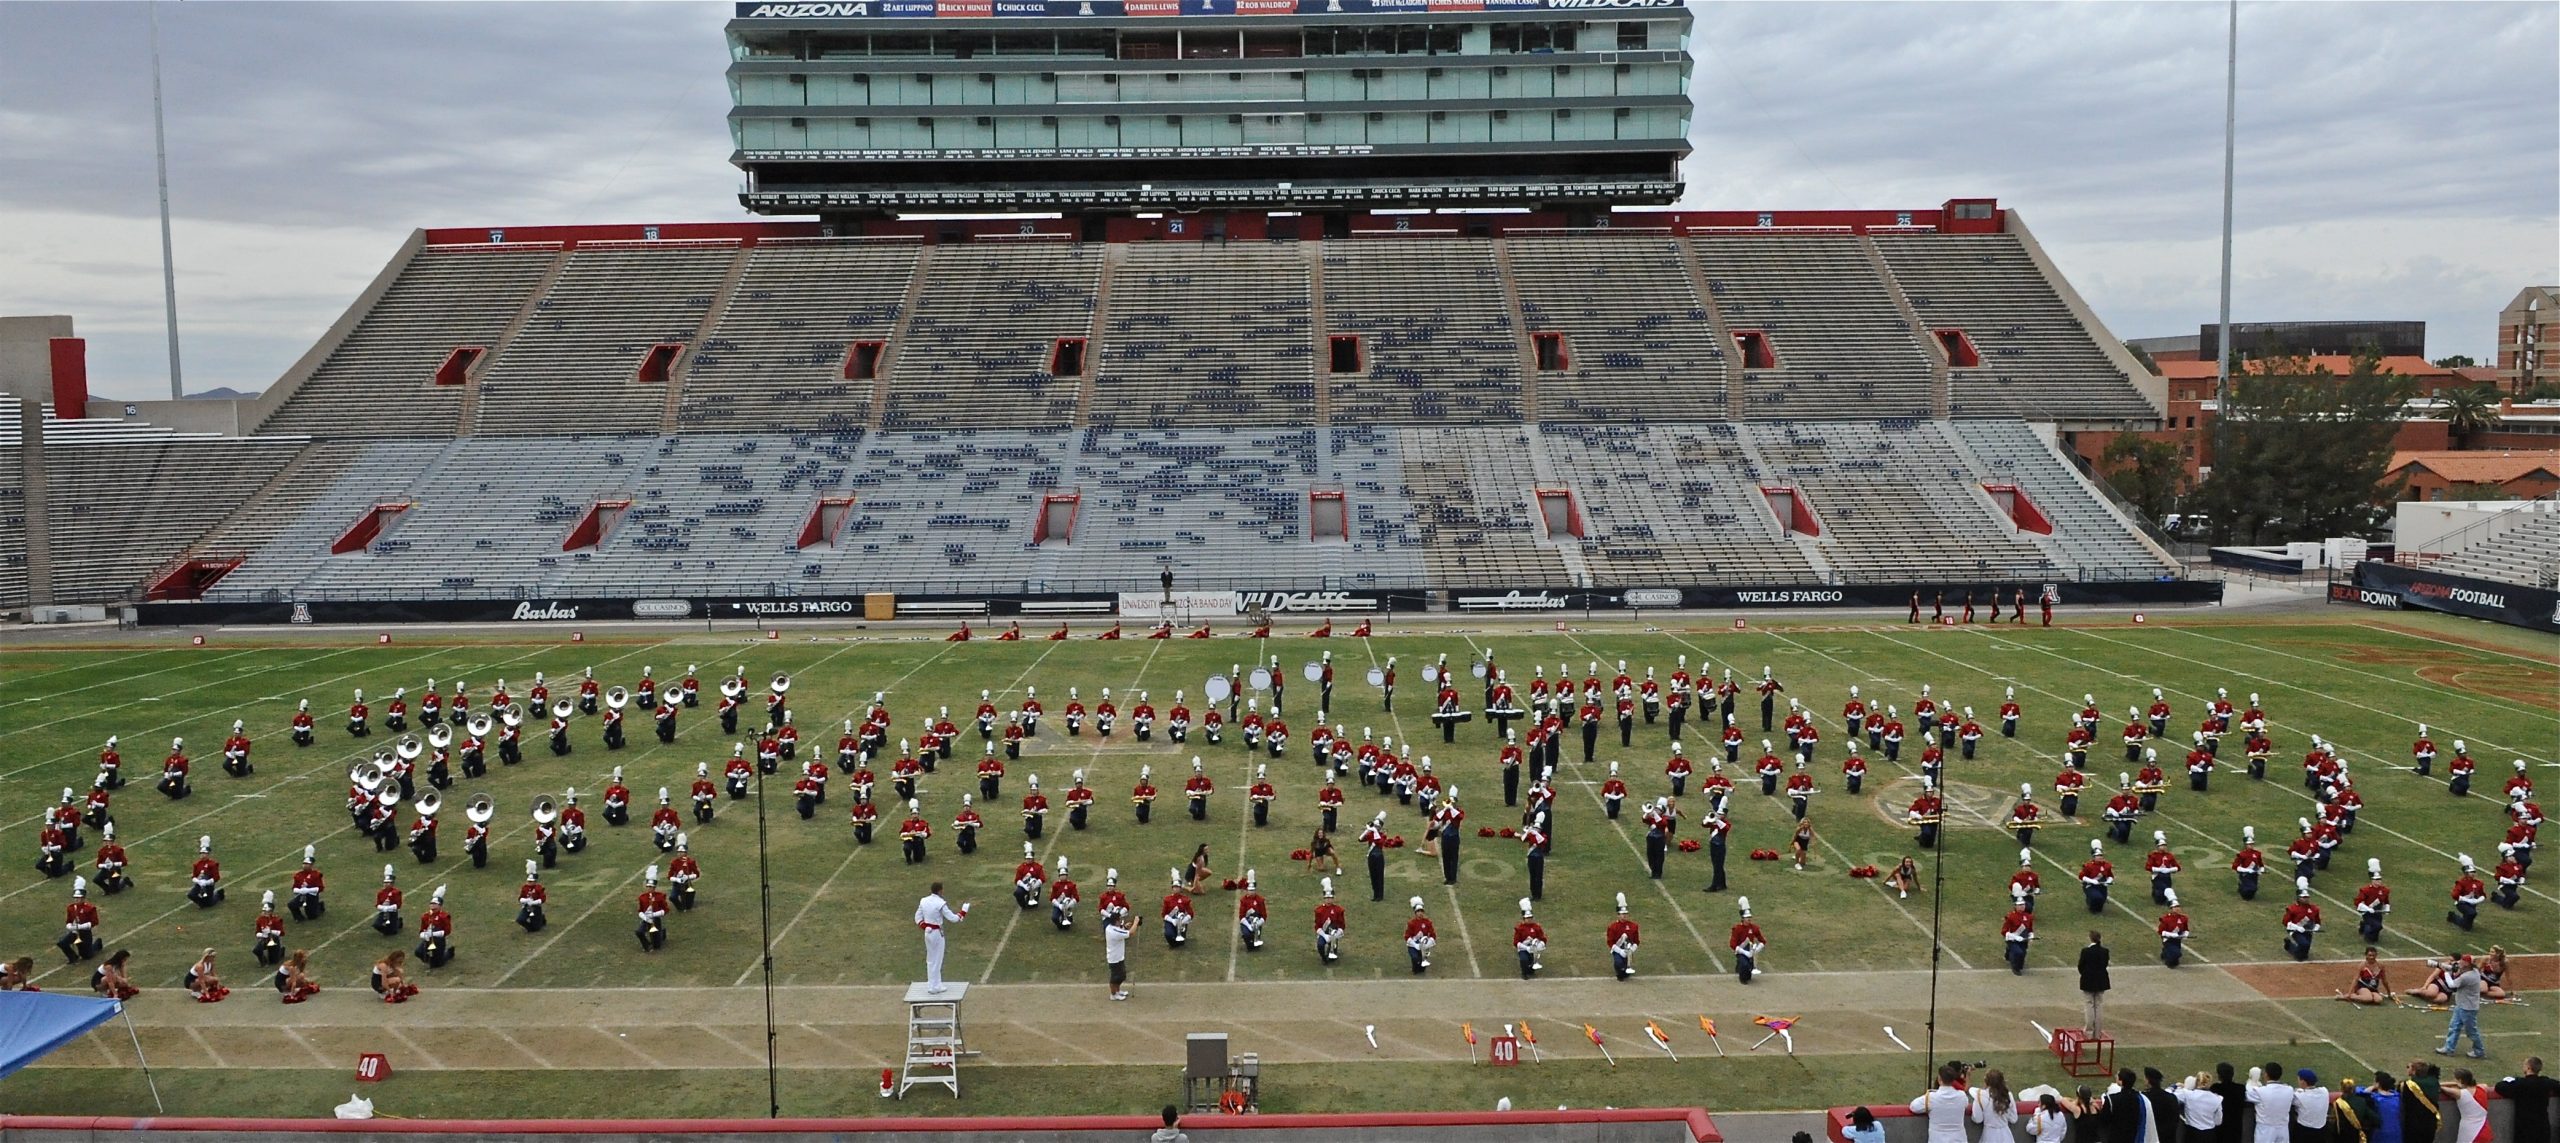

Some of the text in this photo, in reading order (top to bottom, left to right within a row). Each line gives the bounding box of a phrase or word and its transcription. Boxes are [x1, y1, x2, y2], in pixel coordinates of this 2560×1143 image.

[750, 3, 868, 17] ARIZONA
[883, 3, 891, 11] 22
[905, 4, 934, 12] LUPPINO
[1396, 221, 1408, 229] 22
[1595, 219, 1608, 227] 23
[1759, 217, 1772, 227] 24
[1897, 217, 1910, 226] 25
[822, 228, 833, 237] 19
[1020, 225, 1033, 234] 20
[1170, 223, 1182, 232] 21
[491, 233, 501, 244] 17
[646, 231, 657, 240] 18
[126, 405, 136, 415] 16
[1737, 591, 1842, 602] WELLS FARGO
[2361, 590, 2398, 607] DOWN
[2449, 587, 2505, 609] FOOTBALL
[746, 602, 852, 613] WELLS FARGO
[1122, 600, 1157, 609] UNIVERSITY
[1199, 599, 1218, 608] BAND
[1219, 599, 1232, 608] DAY
[291, 603, 312, 623] A
[512, 601, 578, 619] Bashas'
[1495, 1041, 1514, 1061] 40
[358, 1057, 378, 1078] 40
